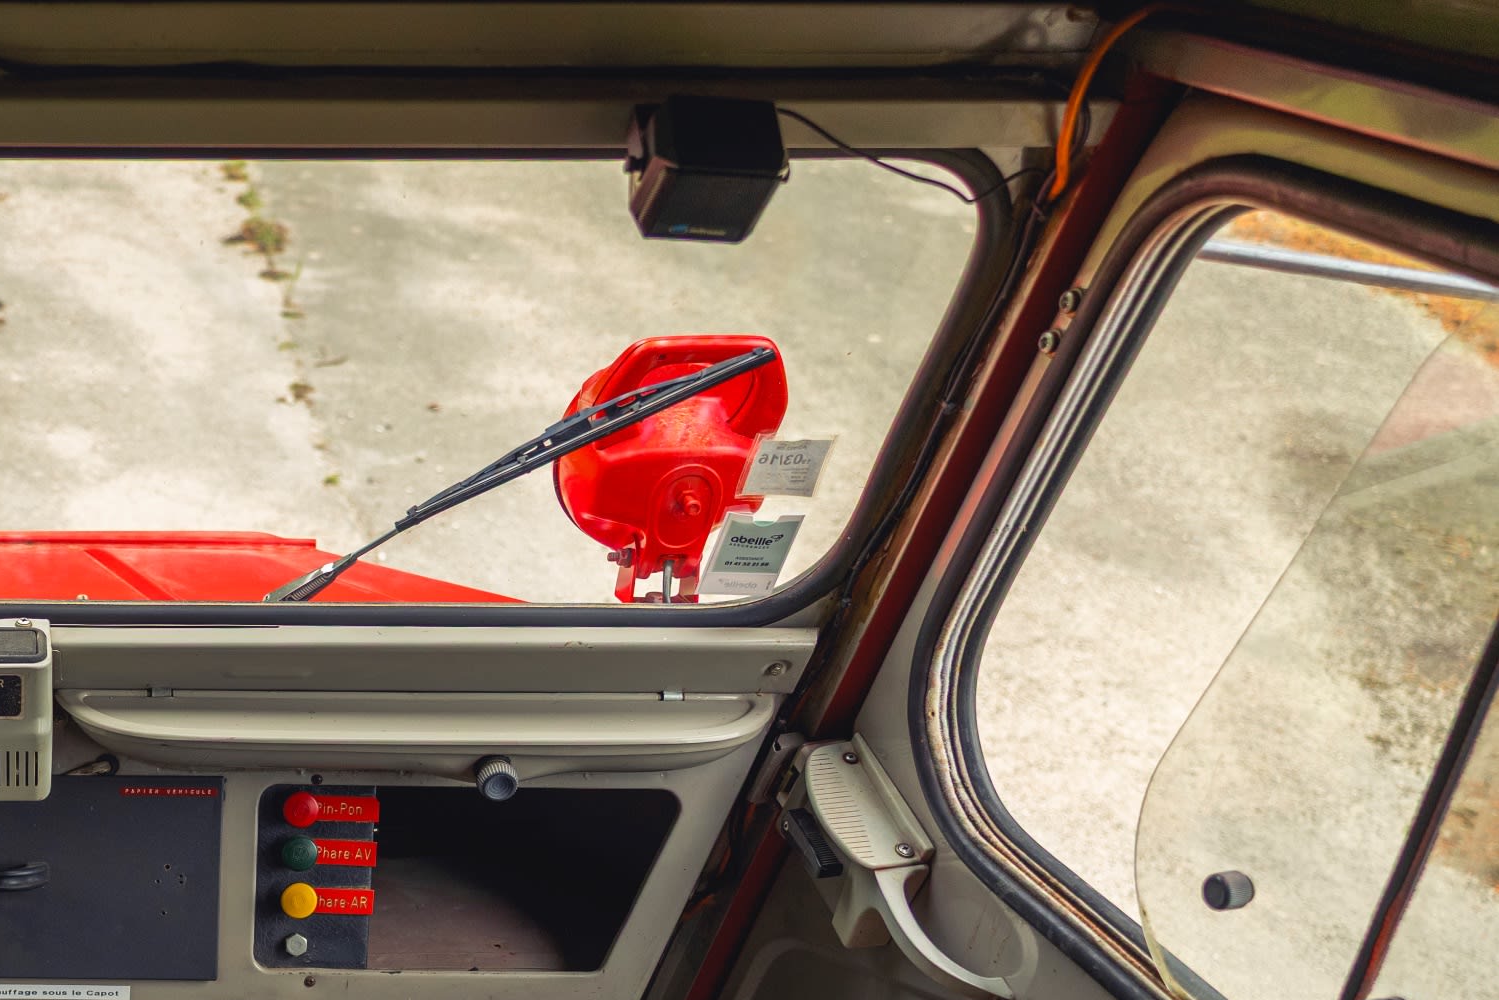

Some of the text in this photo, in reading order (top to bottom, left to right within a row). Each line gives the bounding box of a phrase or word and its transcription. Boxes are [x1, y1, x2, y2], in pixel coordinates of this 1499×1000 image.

[730, 535, 773, 546] abeille
[354, 847, 372, 861] AV
[318, 895, 368, 909] hare AR
[86, 990, 119, 998] Capot
